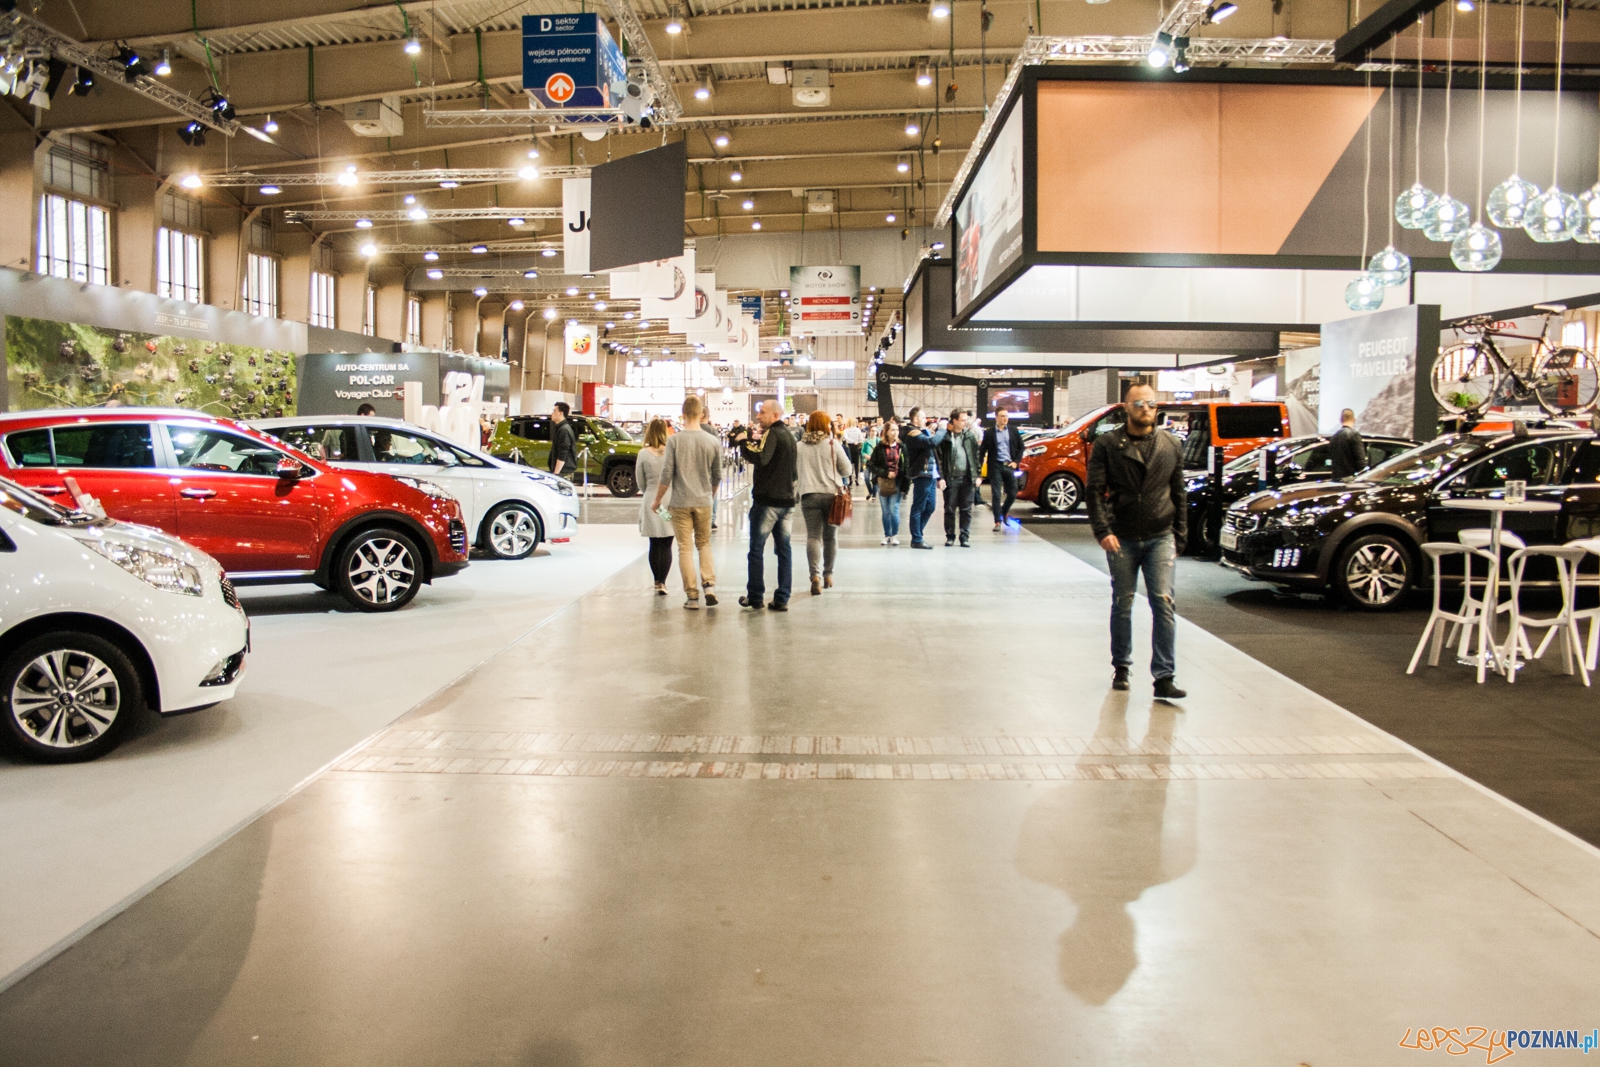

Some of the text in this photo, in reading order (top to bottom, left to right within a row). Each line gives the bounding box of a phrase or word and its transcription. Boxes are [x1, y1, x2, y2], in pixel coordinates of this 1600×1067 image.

[541, 18, 552, 32] D
[555, 17, 579, 25] sektor
[528, 48, 591, 57] wejście północne
[1358, 337, 1409, 358] PEUGEOT
[335, 363, 410, 372] AUTO-CENTRUM SA
[1349, 358, 1408, 379] TRAVELLER
[349, 375, 395, 385] POL-CAR
[334, 390, 372, 399] Voyager
[372, 389, 393, 398] Club
